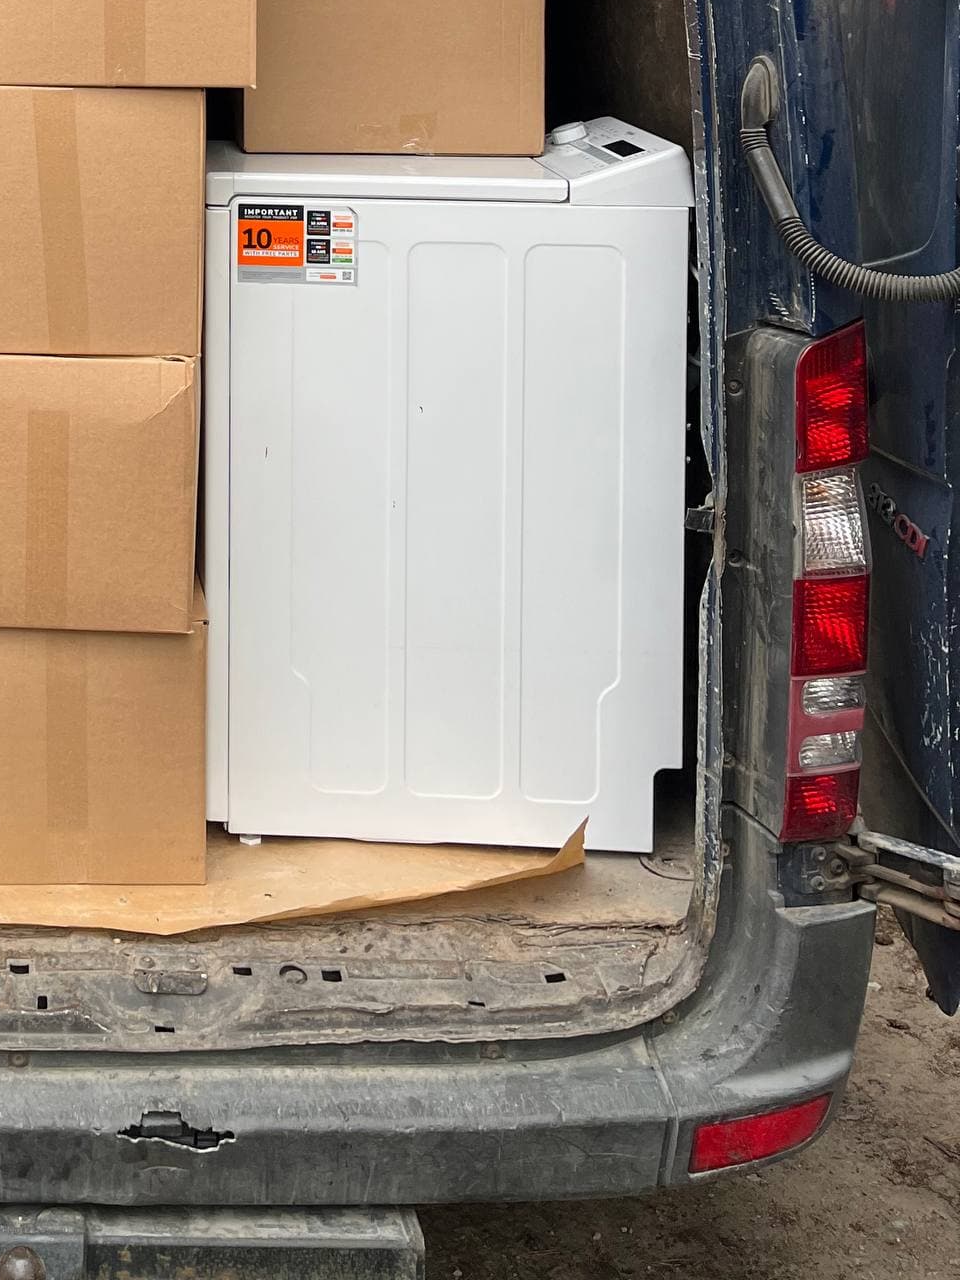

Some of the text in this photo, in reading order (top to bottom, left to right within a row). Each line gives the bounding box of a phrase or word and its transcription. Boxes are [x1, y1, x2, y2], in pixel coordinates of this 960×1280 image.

[244, 208, 298, 216] IMPORTANT
[242, 228, 272, 249] 10
[273, 236, 299, 244] YEARS
[893, 513, 931, 559] CDI
